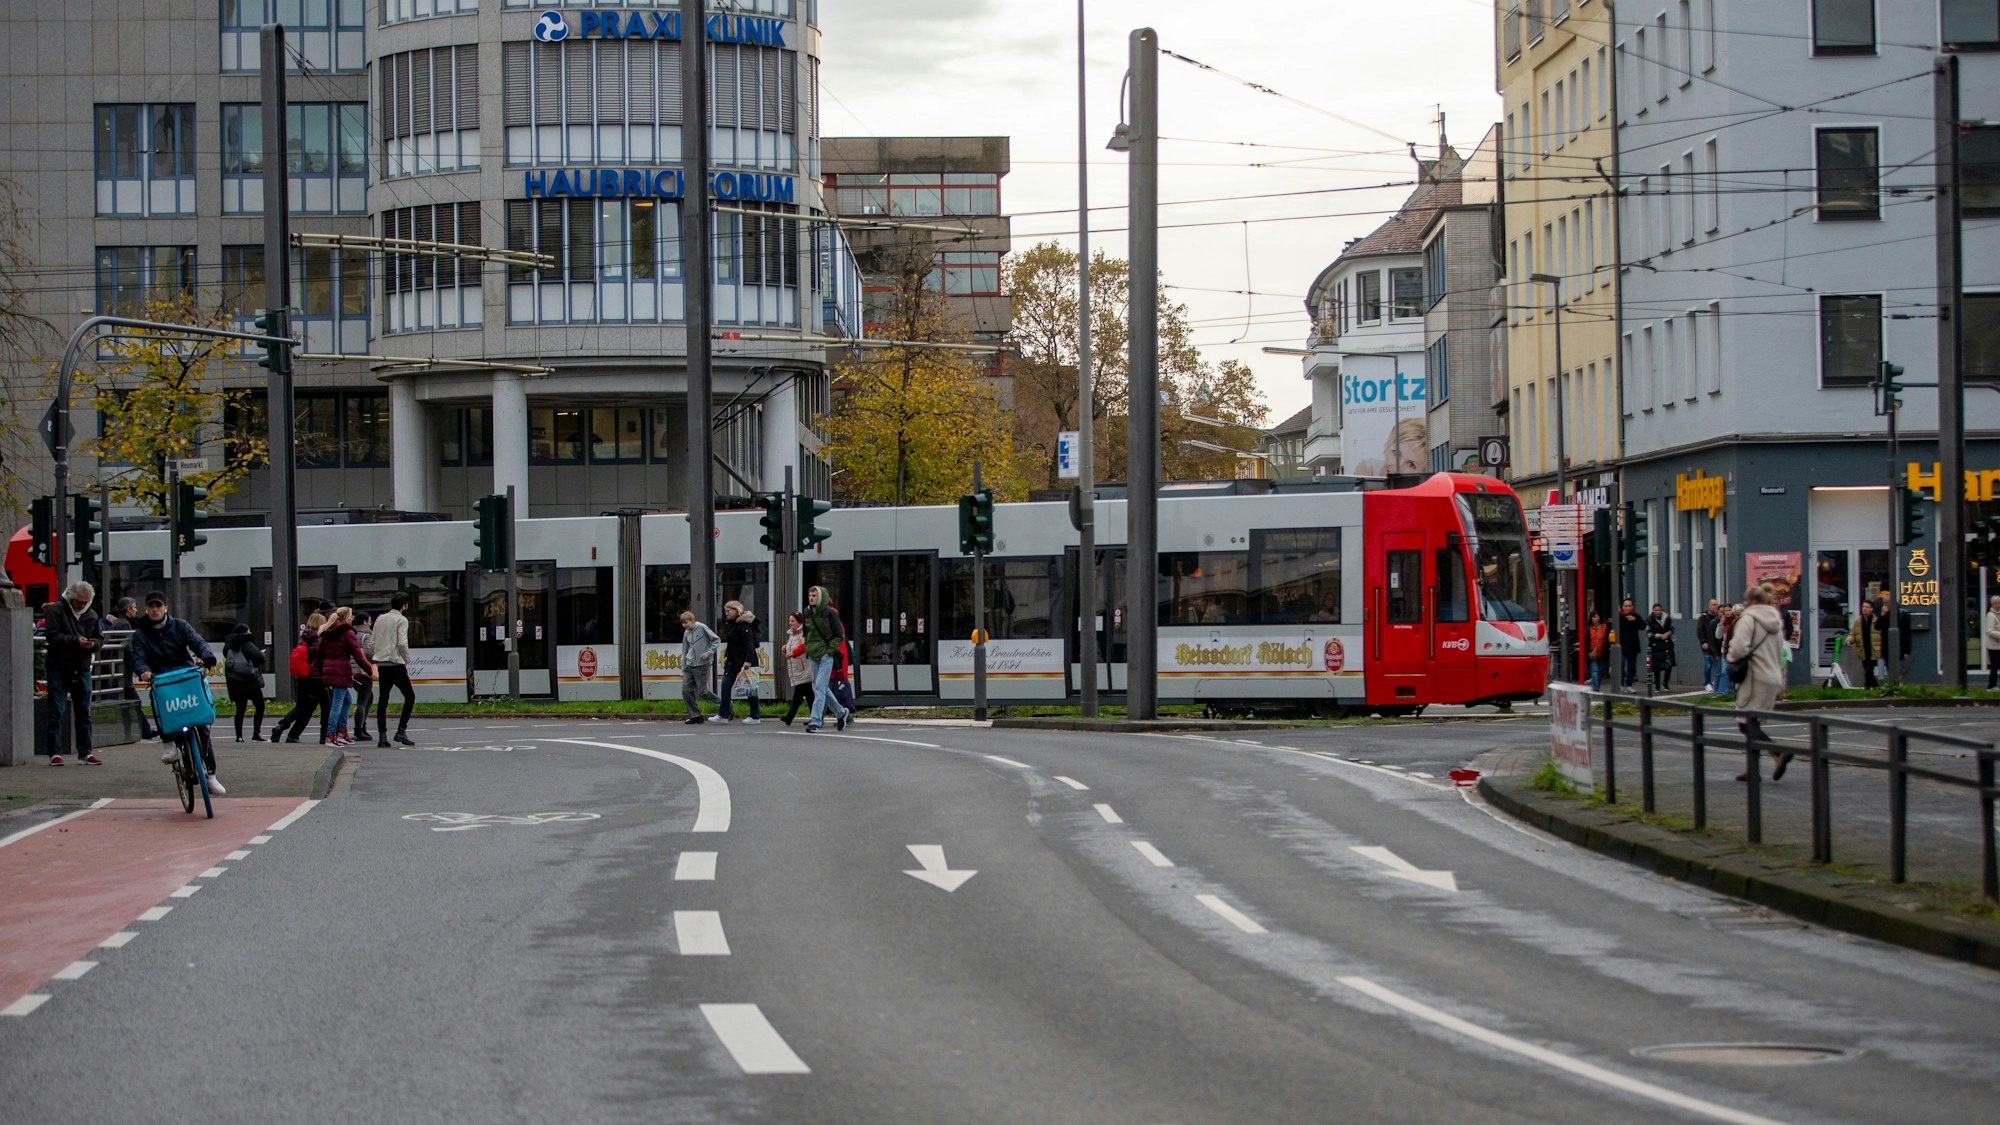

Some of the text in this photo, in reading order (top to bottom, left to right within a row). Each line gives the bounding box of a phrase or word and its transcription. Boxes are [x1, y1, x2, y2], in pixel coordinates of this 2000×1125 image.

[581, 11, 786, 47] PRAXIKLINIK
[1344, 371, 1425, 404] Stortz
[180, 461, 204, 469] Neumarkt
[1676, 468, 1724, 519] Hambaga
[1900, 579, 1939, 593] HAM
[1901, 593, 1940, 606] BAGA
[986, 645, 1052, 658] Brautradition
[1442, 640, 1458, 649] KVB
[1174, 640, 1313, 669] Reissdorf Kölsch
[997, 659, 1023, 670] 1894
[165, 694, 200, 713] Wolt
